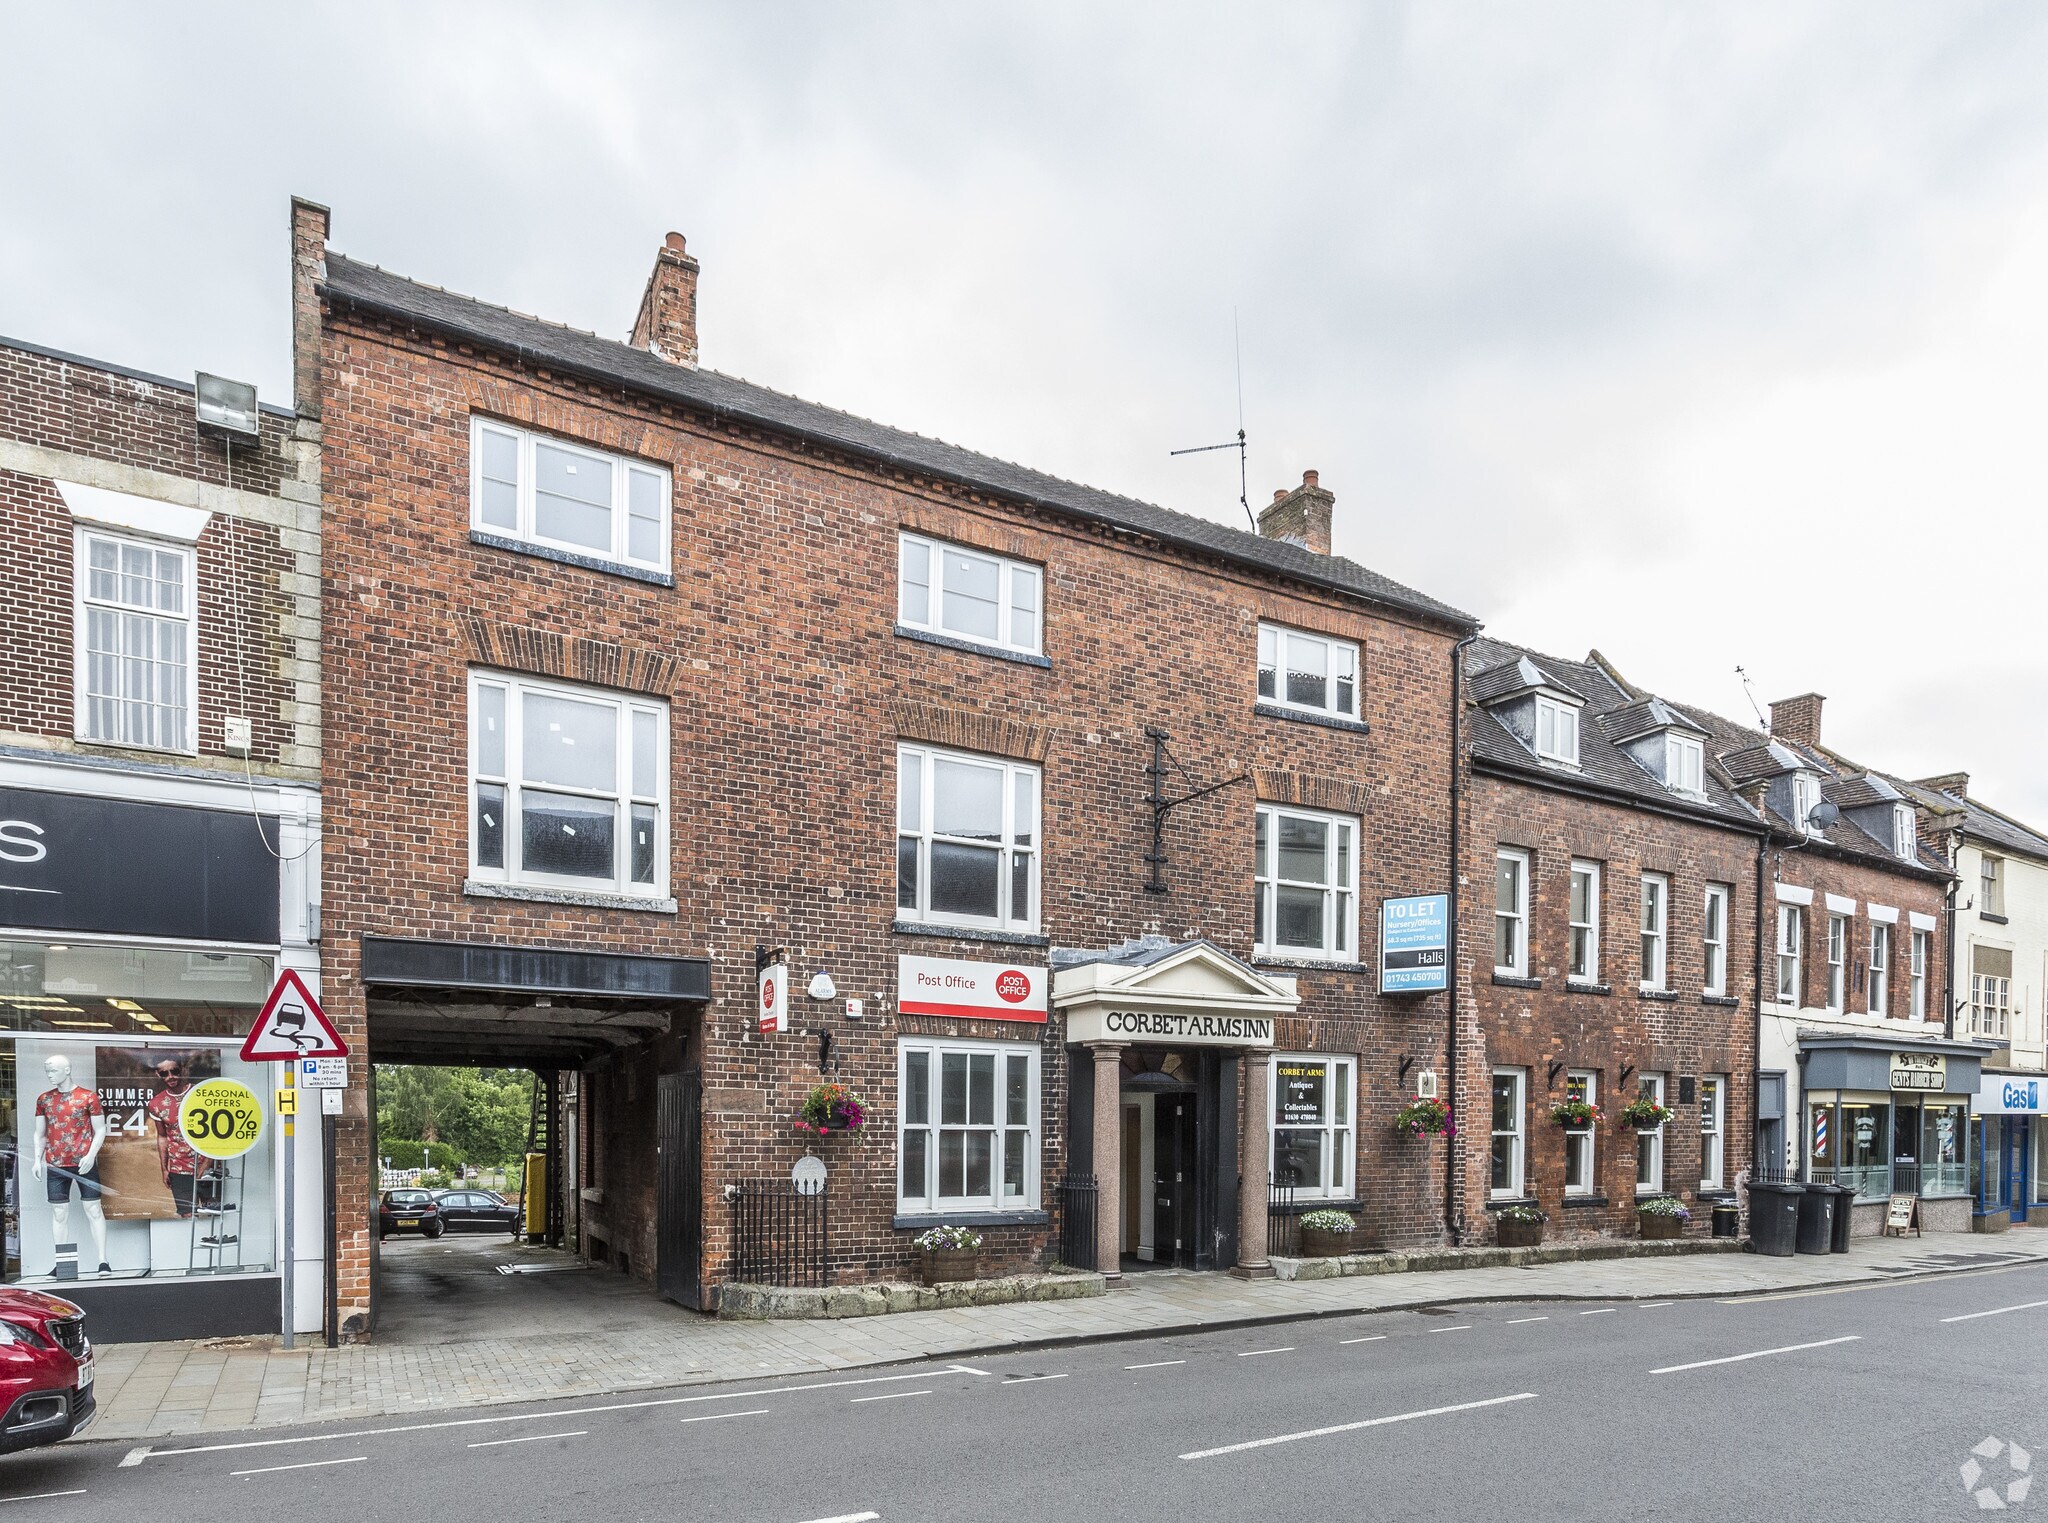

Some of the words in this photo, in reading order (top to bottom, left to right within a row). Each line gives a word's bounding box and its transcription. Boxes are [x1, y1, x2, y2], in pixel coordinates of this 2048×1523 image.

[1388, 905, 1406, 918] TO
[1409, 902, 1436, 917] LET
[1387, 919, 1441, 928] Nursery/Offices
[1418, 951, 1444, 964] Halls
[917, 973, 941, 987] Post
[945, 975, 976, 989] Office
[1003, 976, 1024, 986] POST
[1386, 974, 1410, 983] 01743
[1412, 972, 1441, 982] 450700
[998, 986, 1027, 996] OFFICE
[307, 1061, 315, 1073] P
[1278, 1068, 1305, 1076] CORBET
[1892, 1070, 1910, 1087] GENTS
[1910, 1071, 1930, 1087] BARBER
[1930, 1072, 1944, 1088] SHOP
[1289, 1081, 1313, 1090] Antiques
[97, 1088, 154, 1100] SUMMER
[195, 1088, 249, 1099] SEASONAL
[2003, 1082, 2027, 1109] Gas
[204, 1098, 241, 1107] OFFERS
[279, 1091, 295, 1112] H
[1284, 1103, 1317, 1111] Collectables
[105, 1108, 148, 1137] £4
[187, 1108, 257, 1140] 30%
[235, 1130, 257, 1140] OFF
